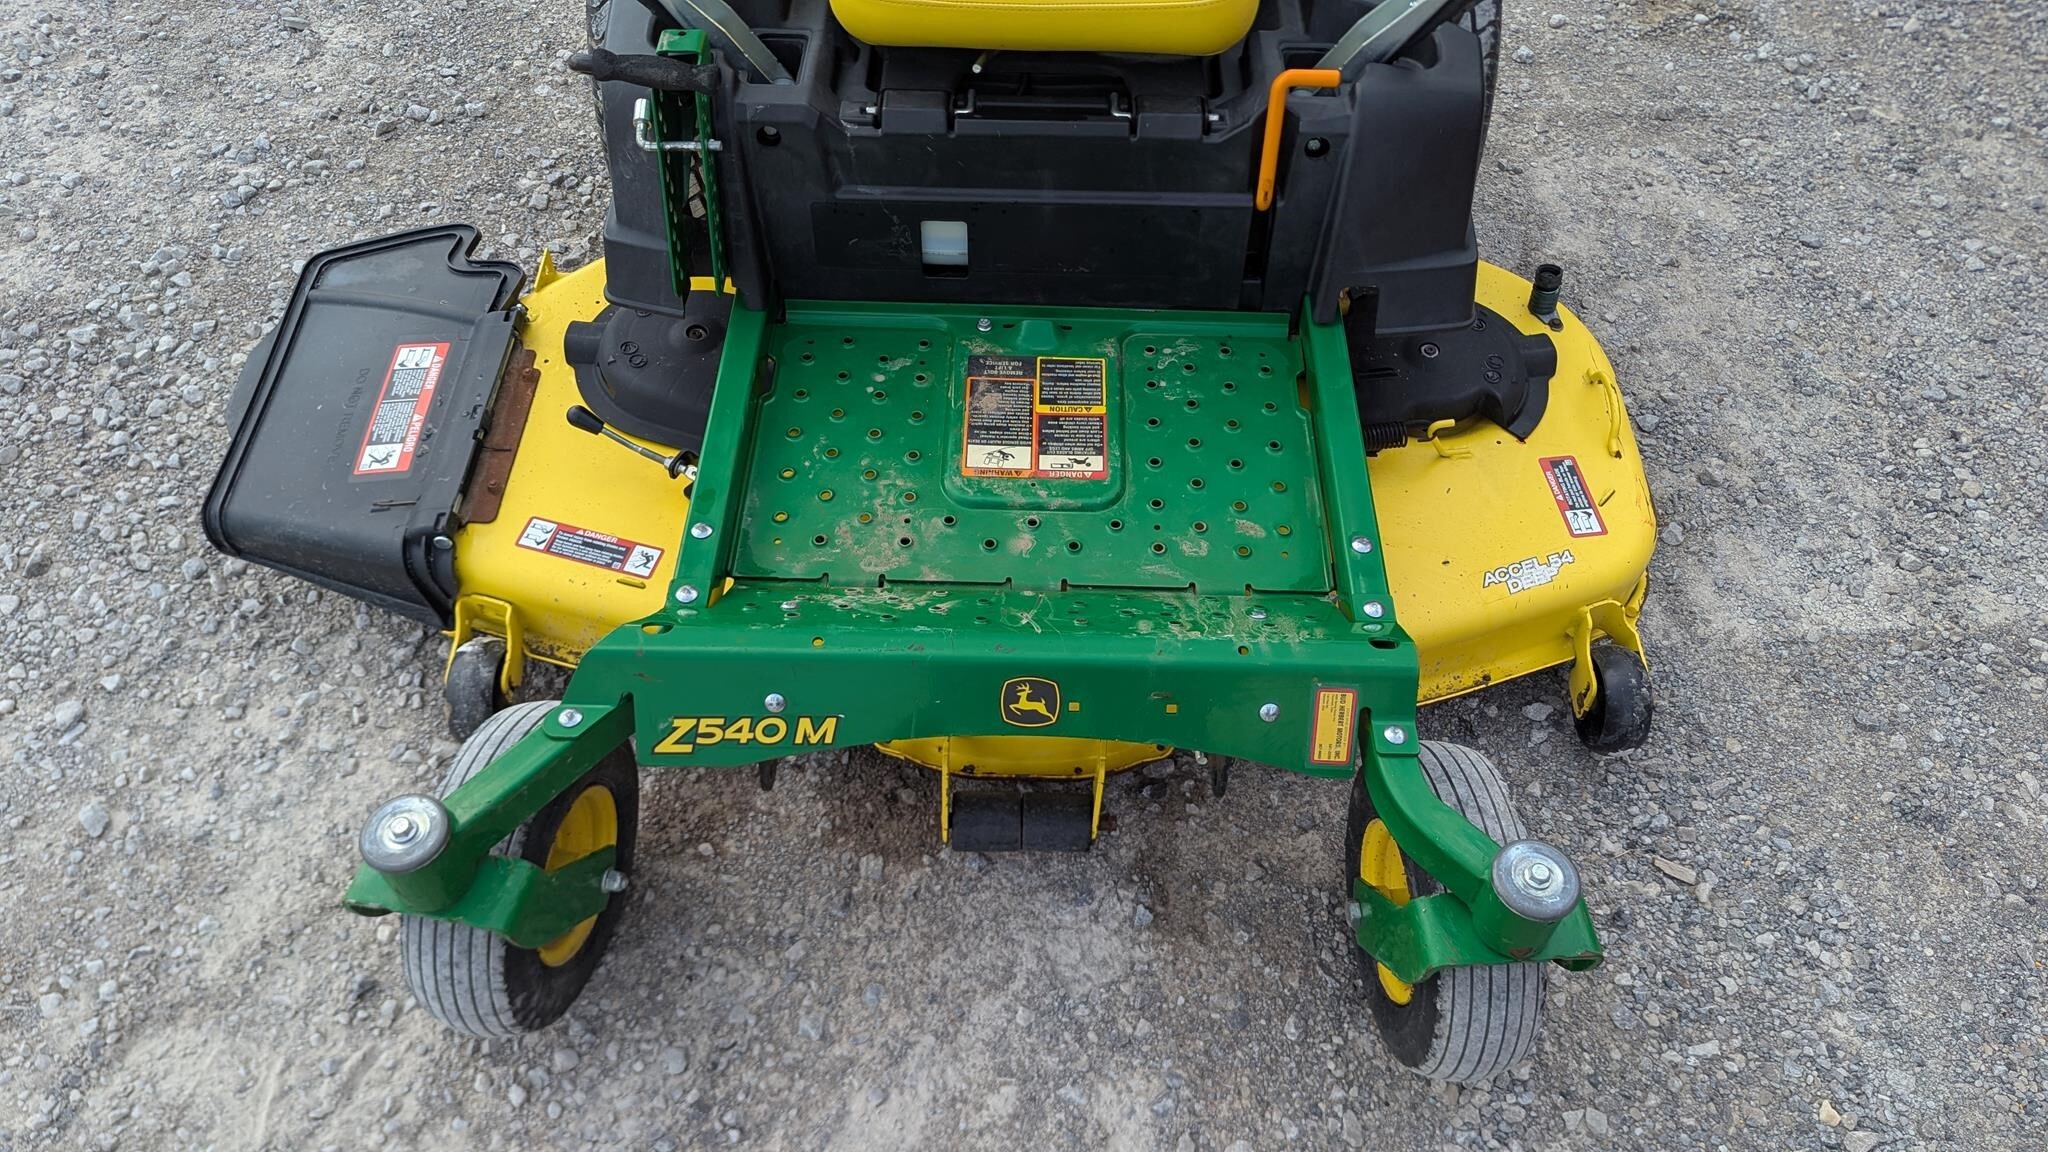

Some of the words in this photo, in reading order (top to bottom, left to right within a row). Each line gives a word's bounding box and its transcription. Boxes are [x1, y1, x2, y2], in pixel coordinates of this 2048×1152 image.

[424, 364, 440, 390] DANGER
[404, 422, 422, 452] PELIGRO
[1546, 471, 1560, 494] DANGER
[584, 531, 618, 543] DANGER
[653, 716, 788, 755] Z540
[793, 716, 838, 745] M
